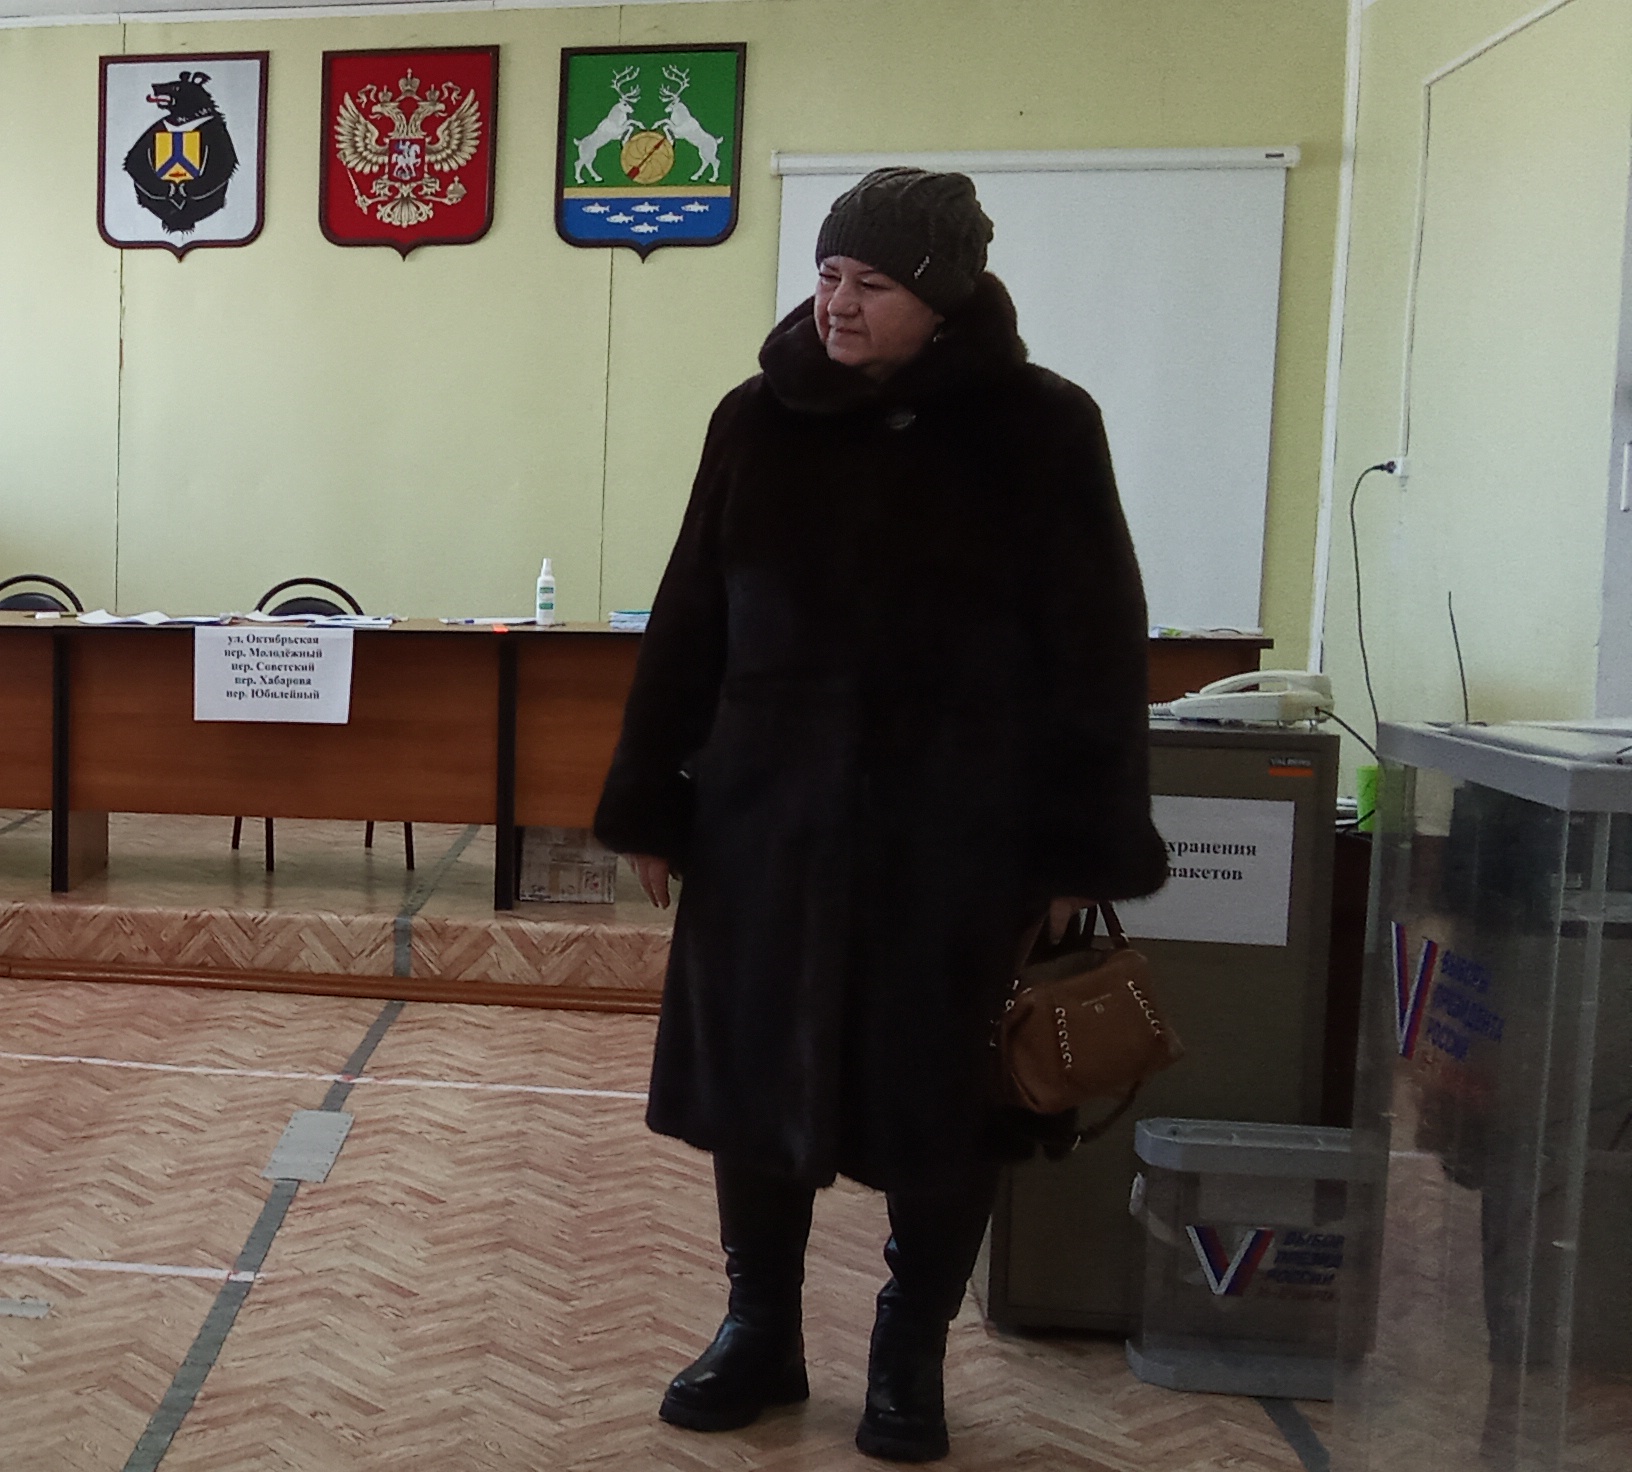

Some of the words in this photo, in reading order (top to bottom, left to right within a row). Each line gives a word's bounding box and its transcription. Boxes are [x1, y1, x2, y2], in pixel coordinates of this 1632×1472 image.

[227, 636, 243, 646] ул.
[246, 633, 319, 646] Октябрьская
[224, 650, 246, 659] пер.
[249, 648, 323, 659] Молодёжный
[231, 663, 253, 673] пер.
[256, 661, 315, 672] Советский
[234, 677, 257, 687] пер.
[251, 688, 320, 700] Юбилейный
[1167, 841, 1257, 857] хранения
